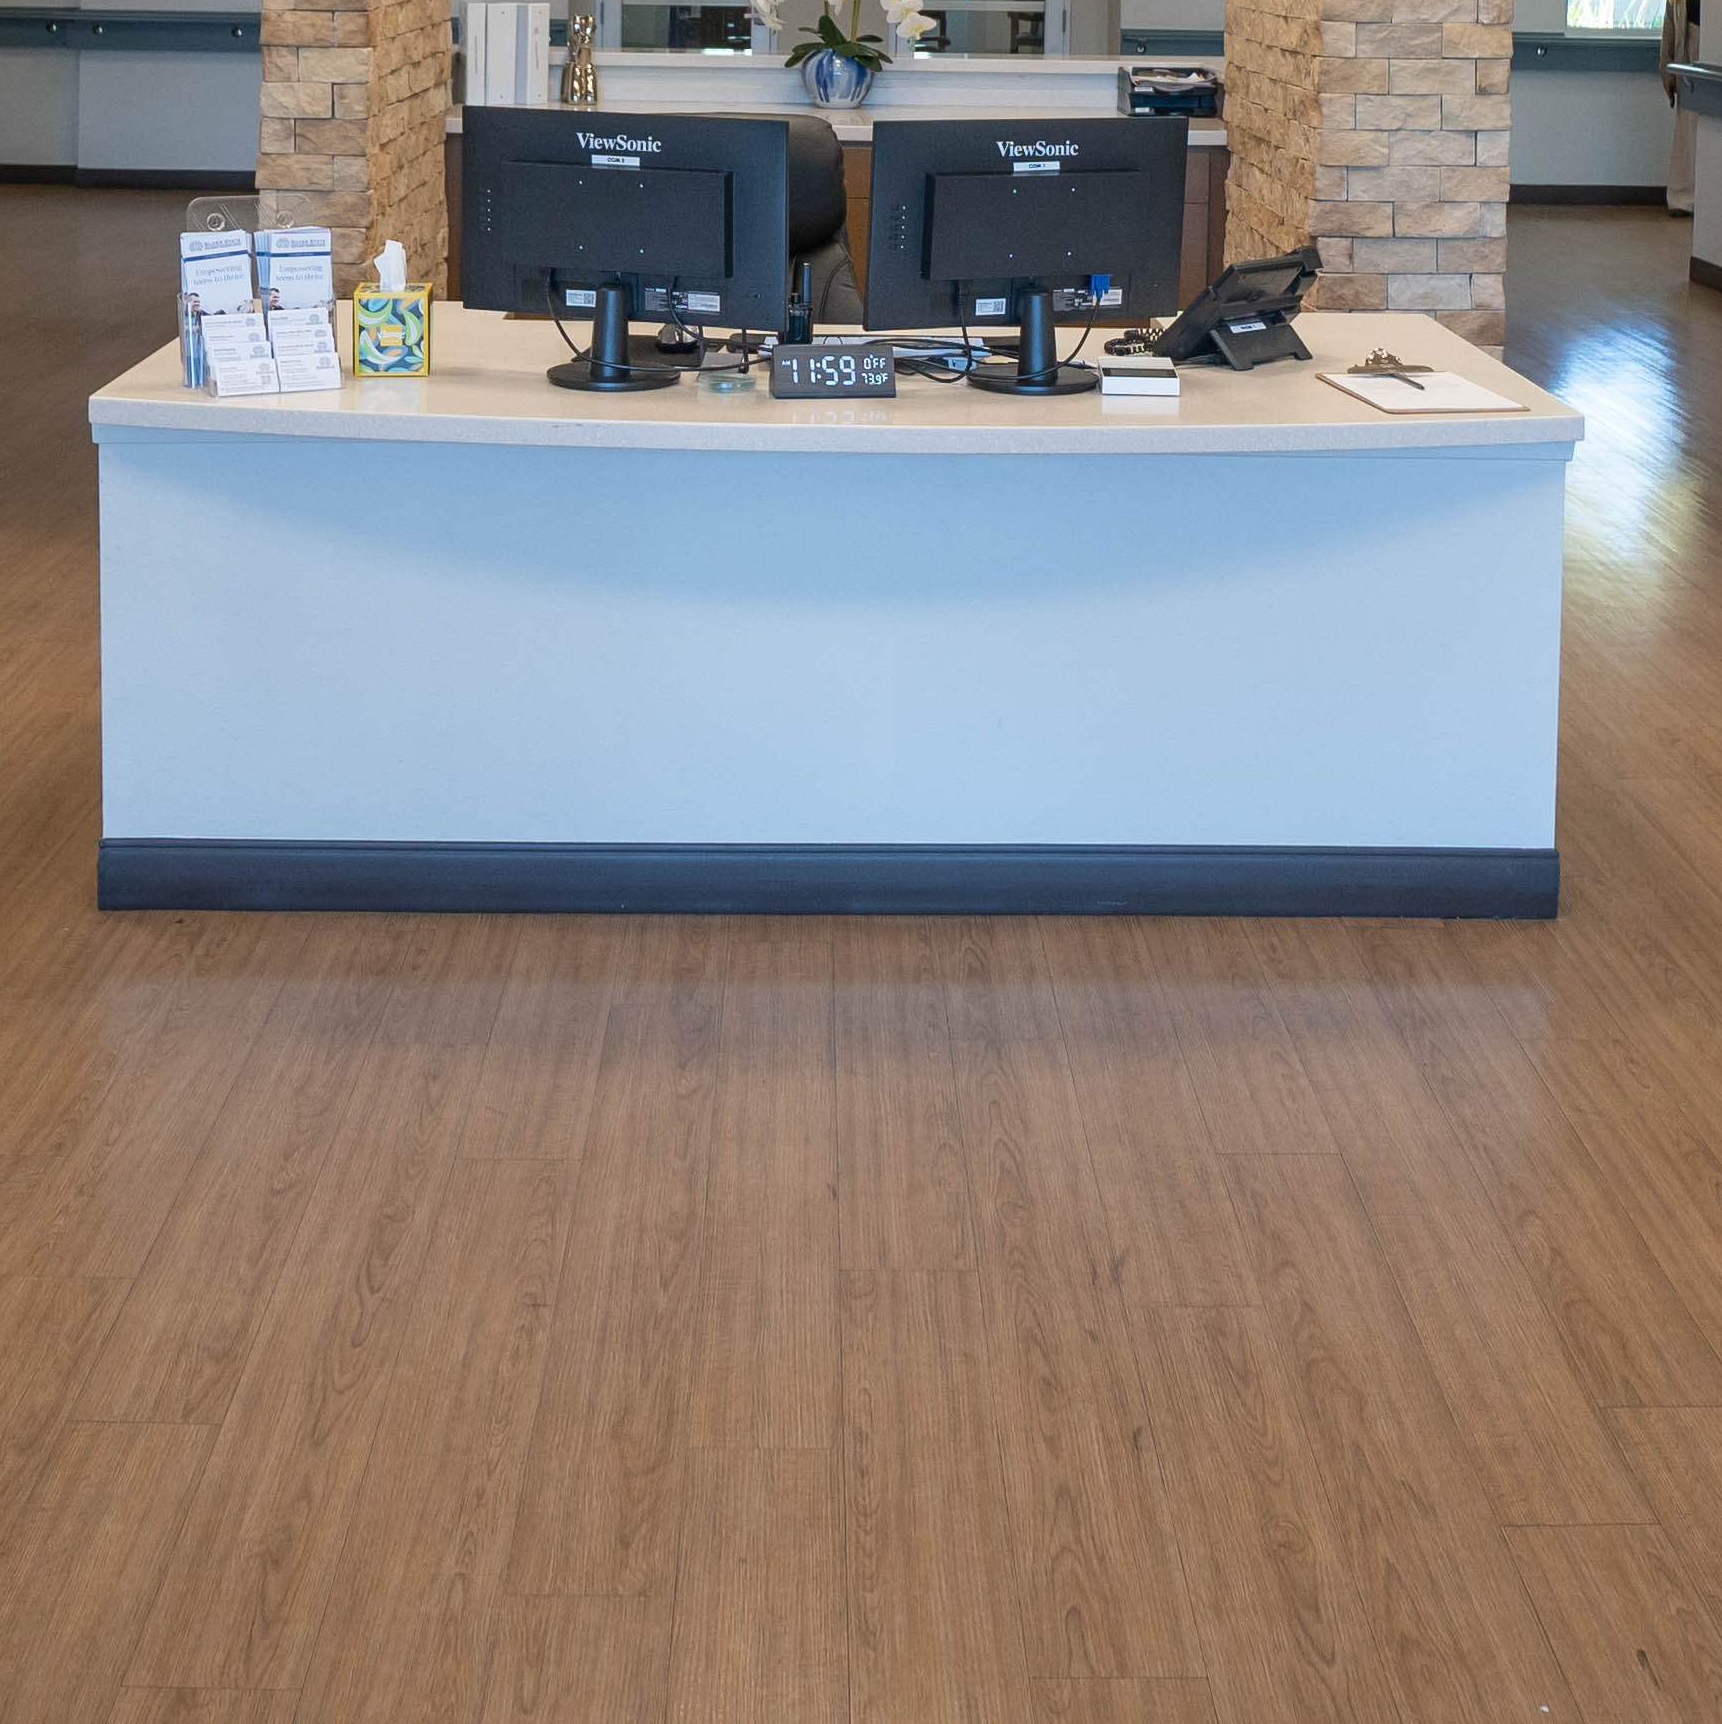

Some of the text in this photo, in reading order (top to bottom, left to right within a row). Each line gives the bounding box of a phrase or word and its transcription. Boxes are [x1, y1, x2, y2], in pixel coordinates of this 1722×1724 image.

[576, 132, 662, 153] ViewSonic
[996, 140, 1079, 157] ViewSonic
[792, 356, 856, 386] 11:59
